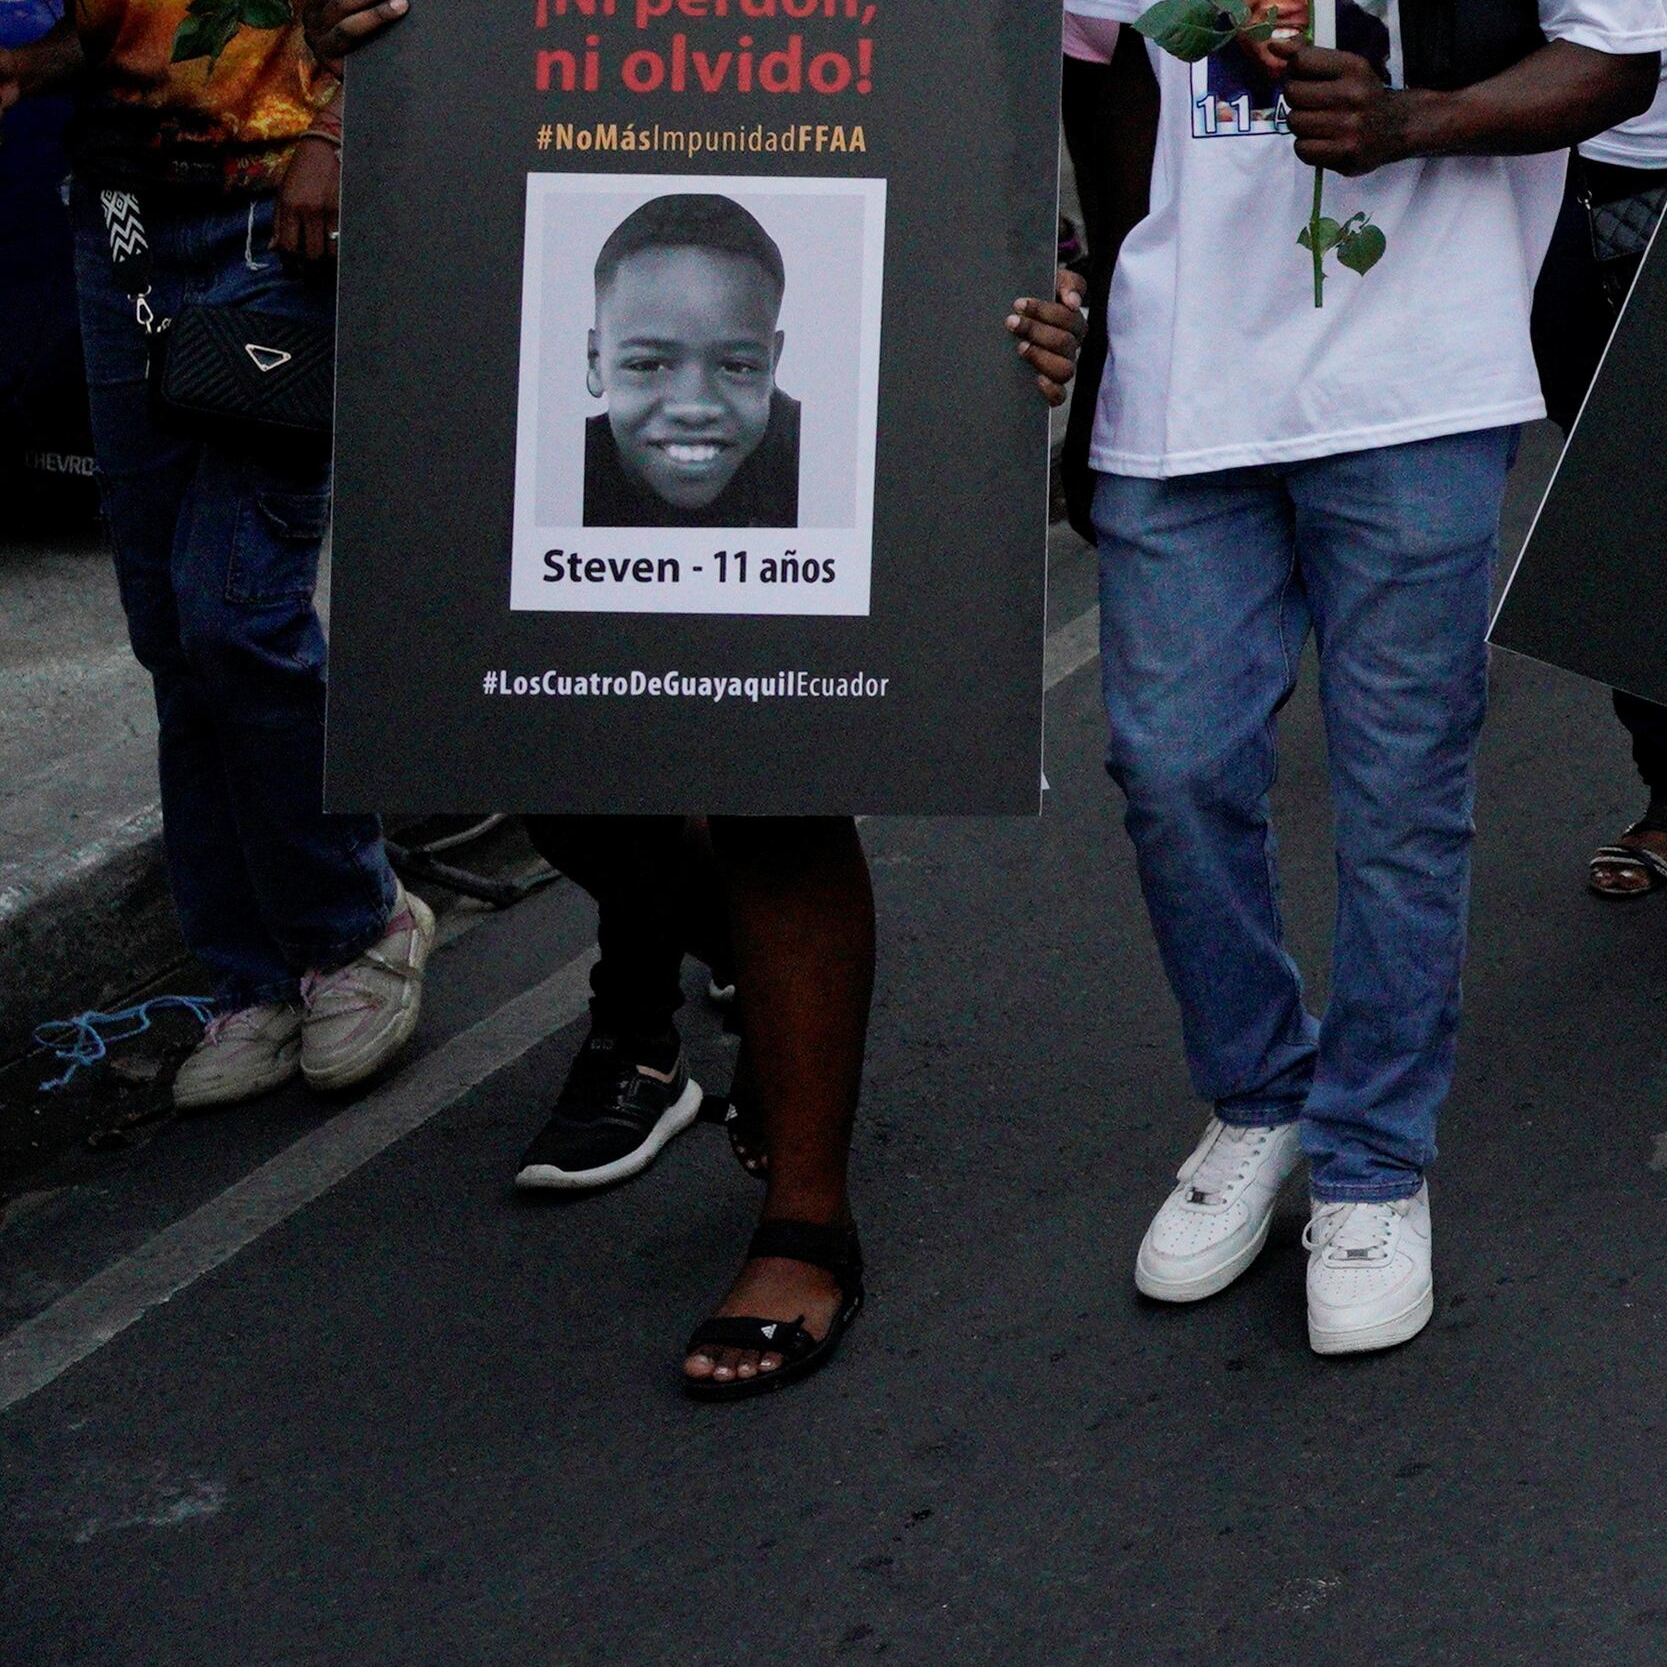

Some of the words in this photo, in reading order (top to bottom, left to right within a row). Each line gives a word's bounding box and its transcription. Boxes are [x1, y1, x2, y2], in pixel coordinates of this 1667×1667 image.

[536, 35, 599, 91] ni
[622, 35, 873, 93] olvido!
[1196, 94, 1251, 134] 11
[538, 125, 864, 156] #NoMásImpunidadFFAA
[24, 449, 95, 477] CHEVRO
[544, 550, 679, 582] Steven
[714, 551, 746, 582] 11
[760, 550, 835, 583] años
[483, 670, 889, 702] #LosCuatroDeGuayaquilEcuador
